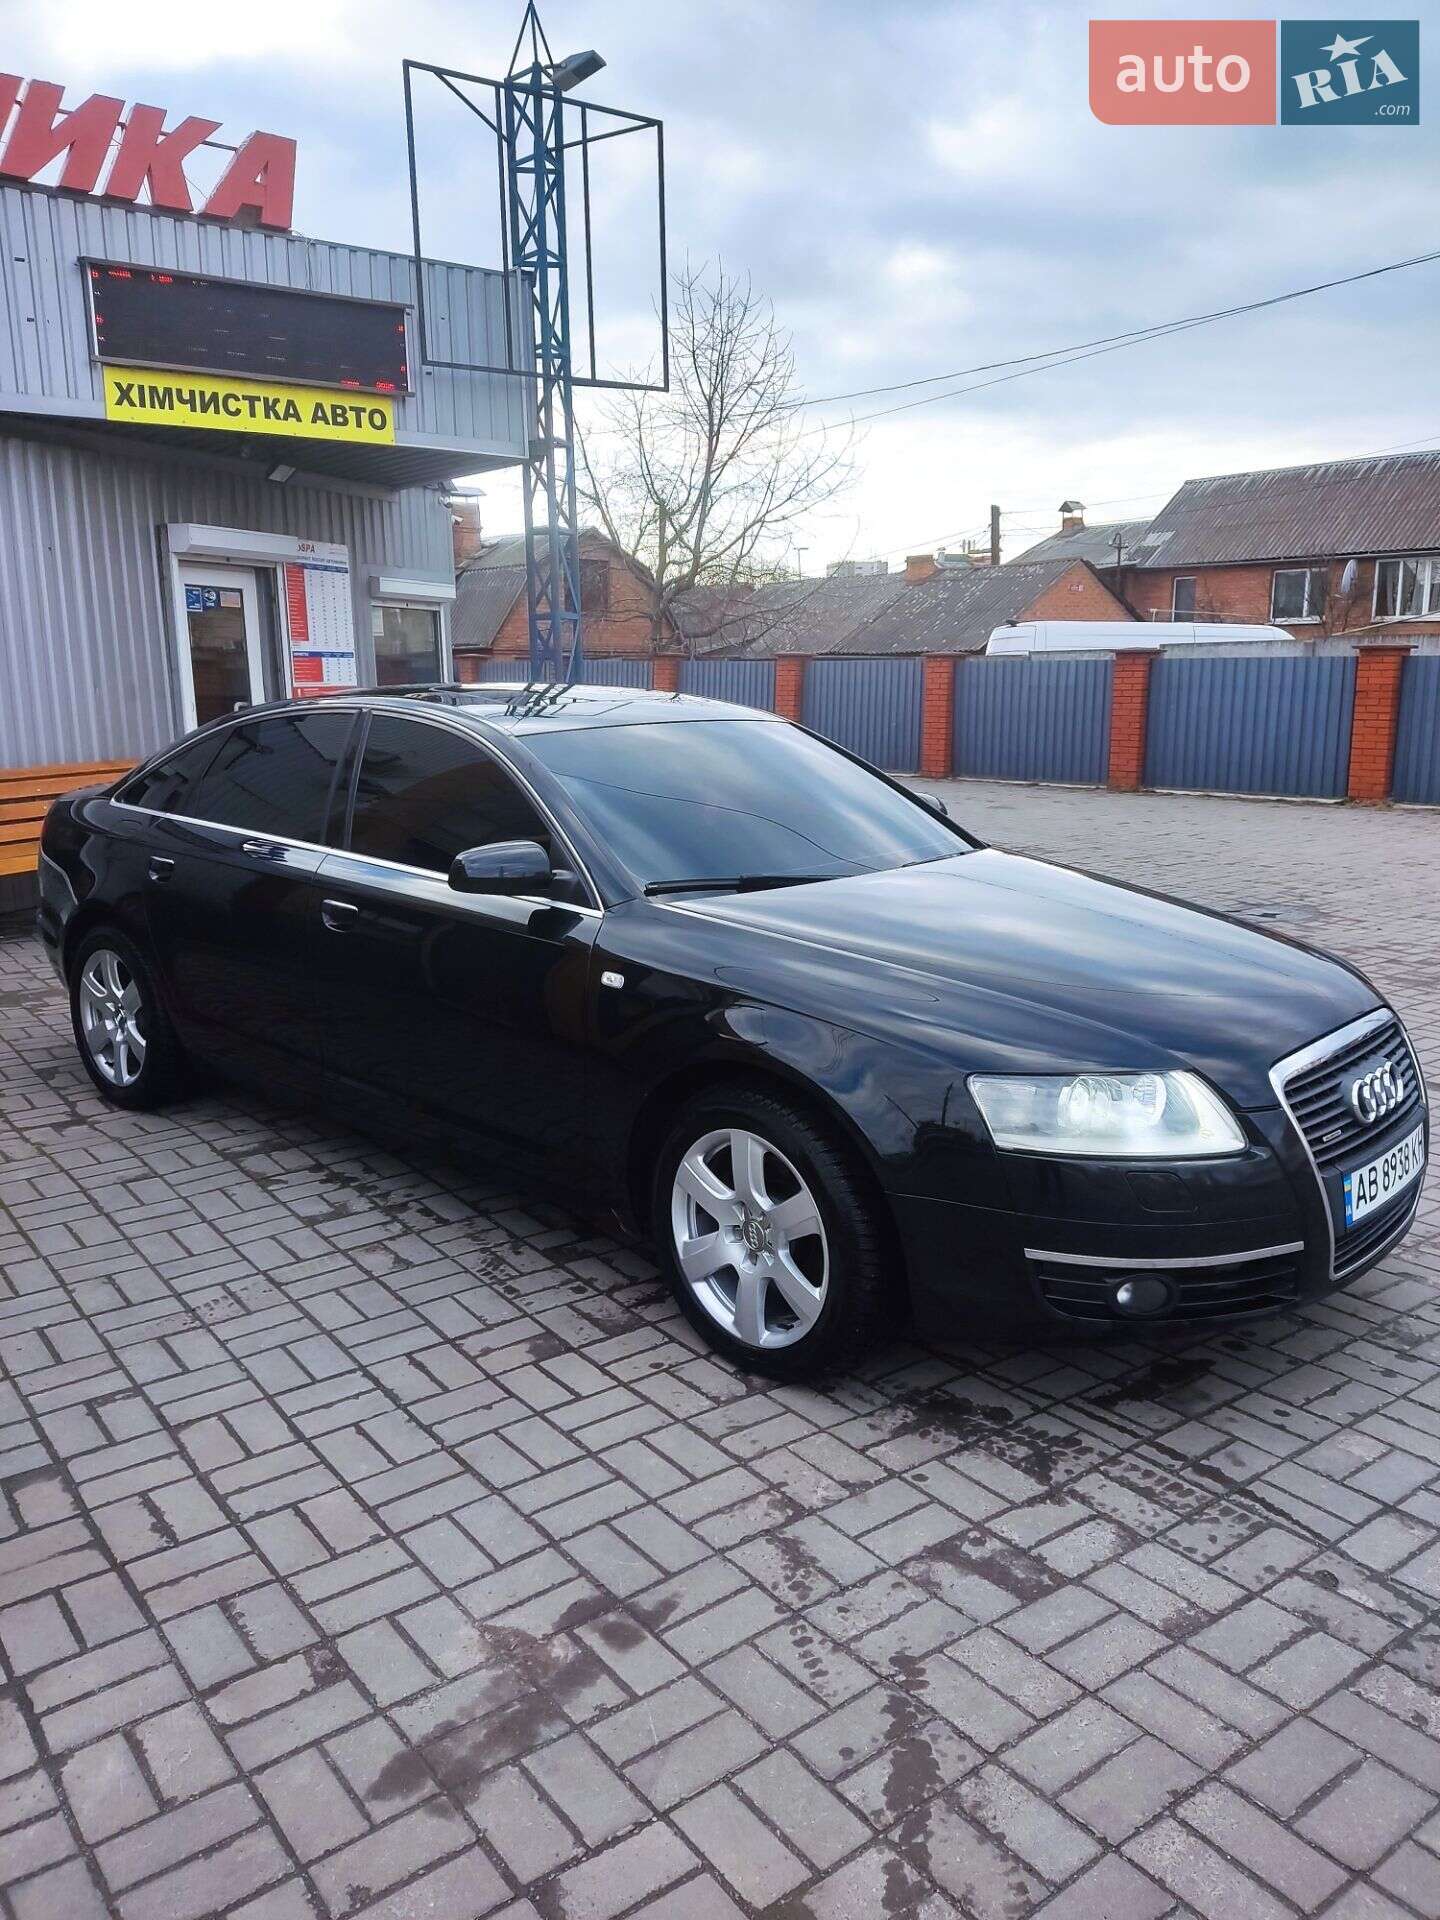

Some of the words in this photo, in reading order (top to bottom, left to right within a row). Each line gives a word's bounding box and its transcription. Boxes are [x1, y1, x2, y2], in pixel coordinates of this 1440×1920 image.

[114, 381, 302, 423] ХІМЧИСТКА
[311, 402, 387, 432] АВТО
[1356, 1165, 1379, 1210] AB
[1382, 1142, 1410, 1192] 8938
